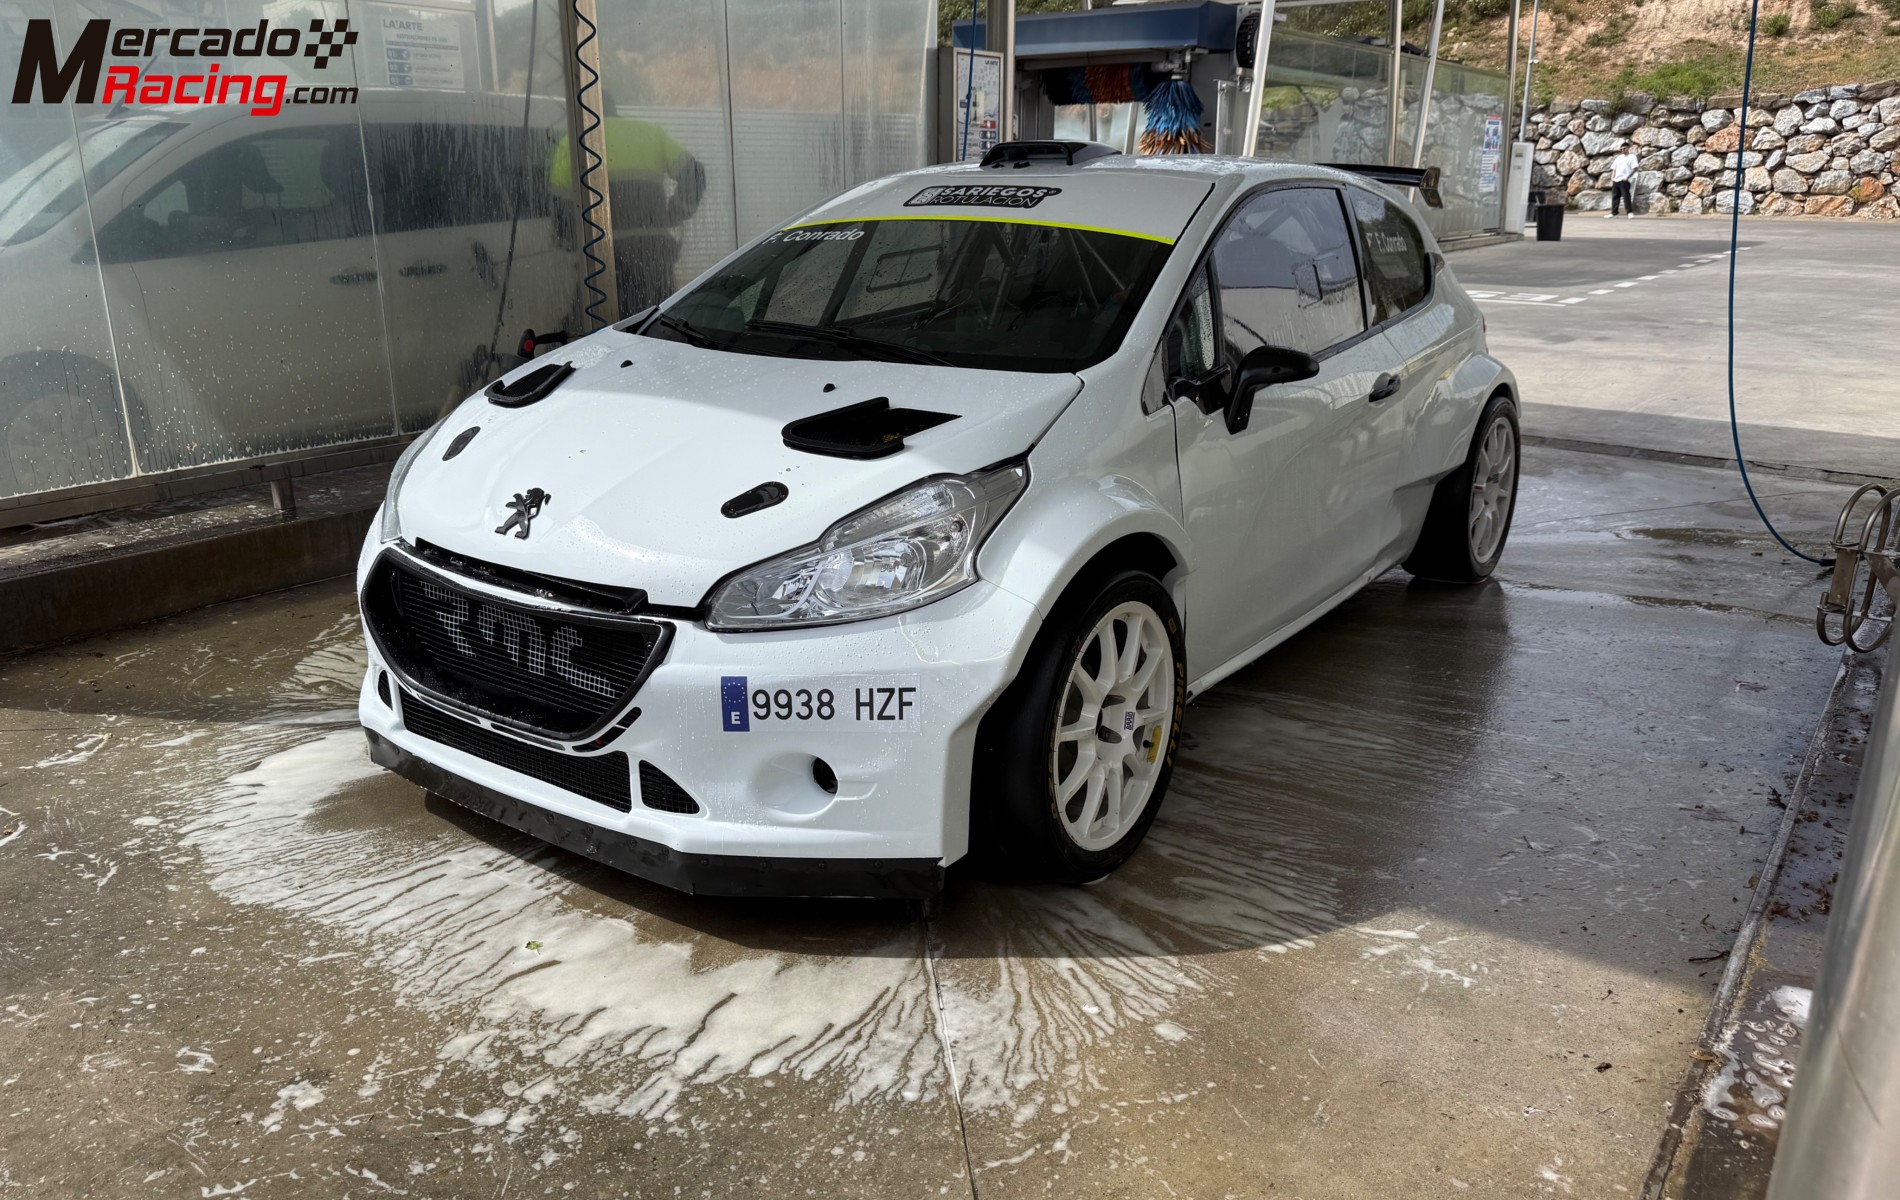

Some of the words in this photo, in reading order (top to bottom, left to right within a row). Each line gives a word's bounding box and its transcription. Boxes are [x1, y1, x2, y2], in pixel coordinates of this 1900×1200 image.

[940, 187, 1048, 198] SARIEGOS
[783, 229, 865, 242] Conrado
[752, 688, 835, 721] 9938
[855, 687, 917, 721] HZF
[731, 711, 741, 724] E
[1166, 662, 1185, 768] PIRELLI
